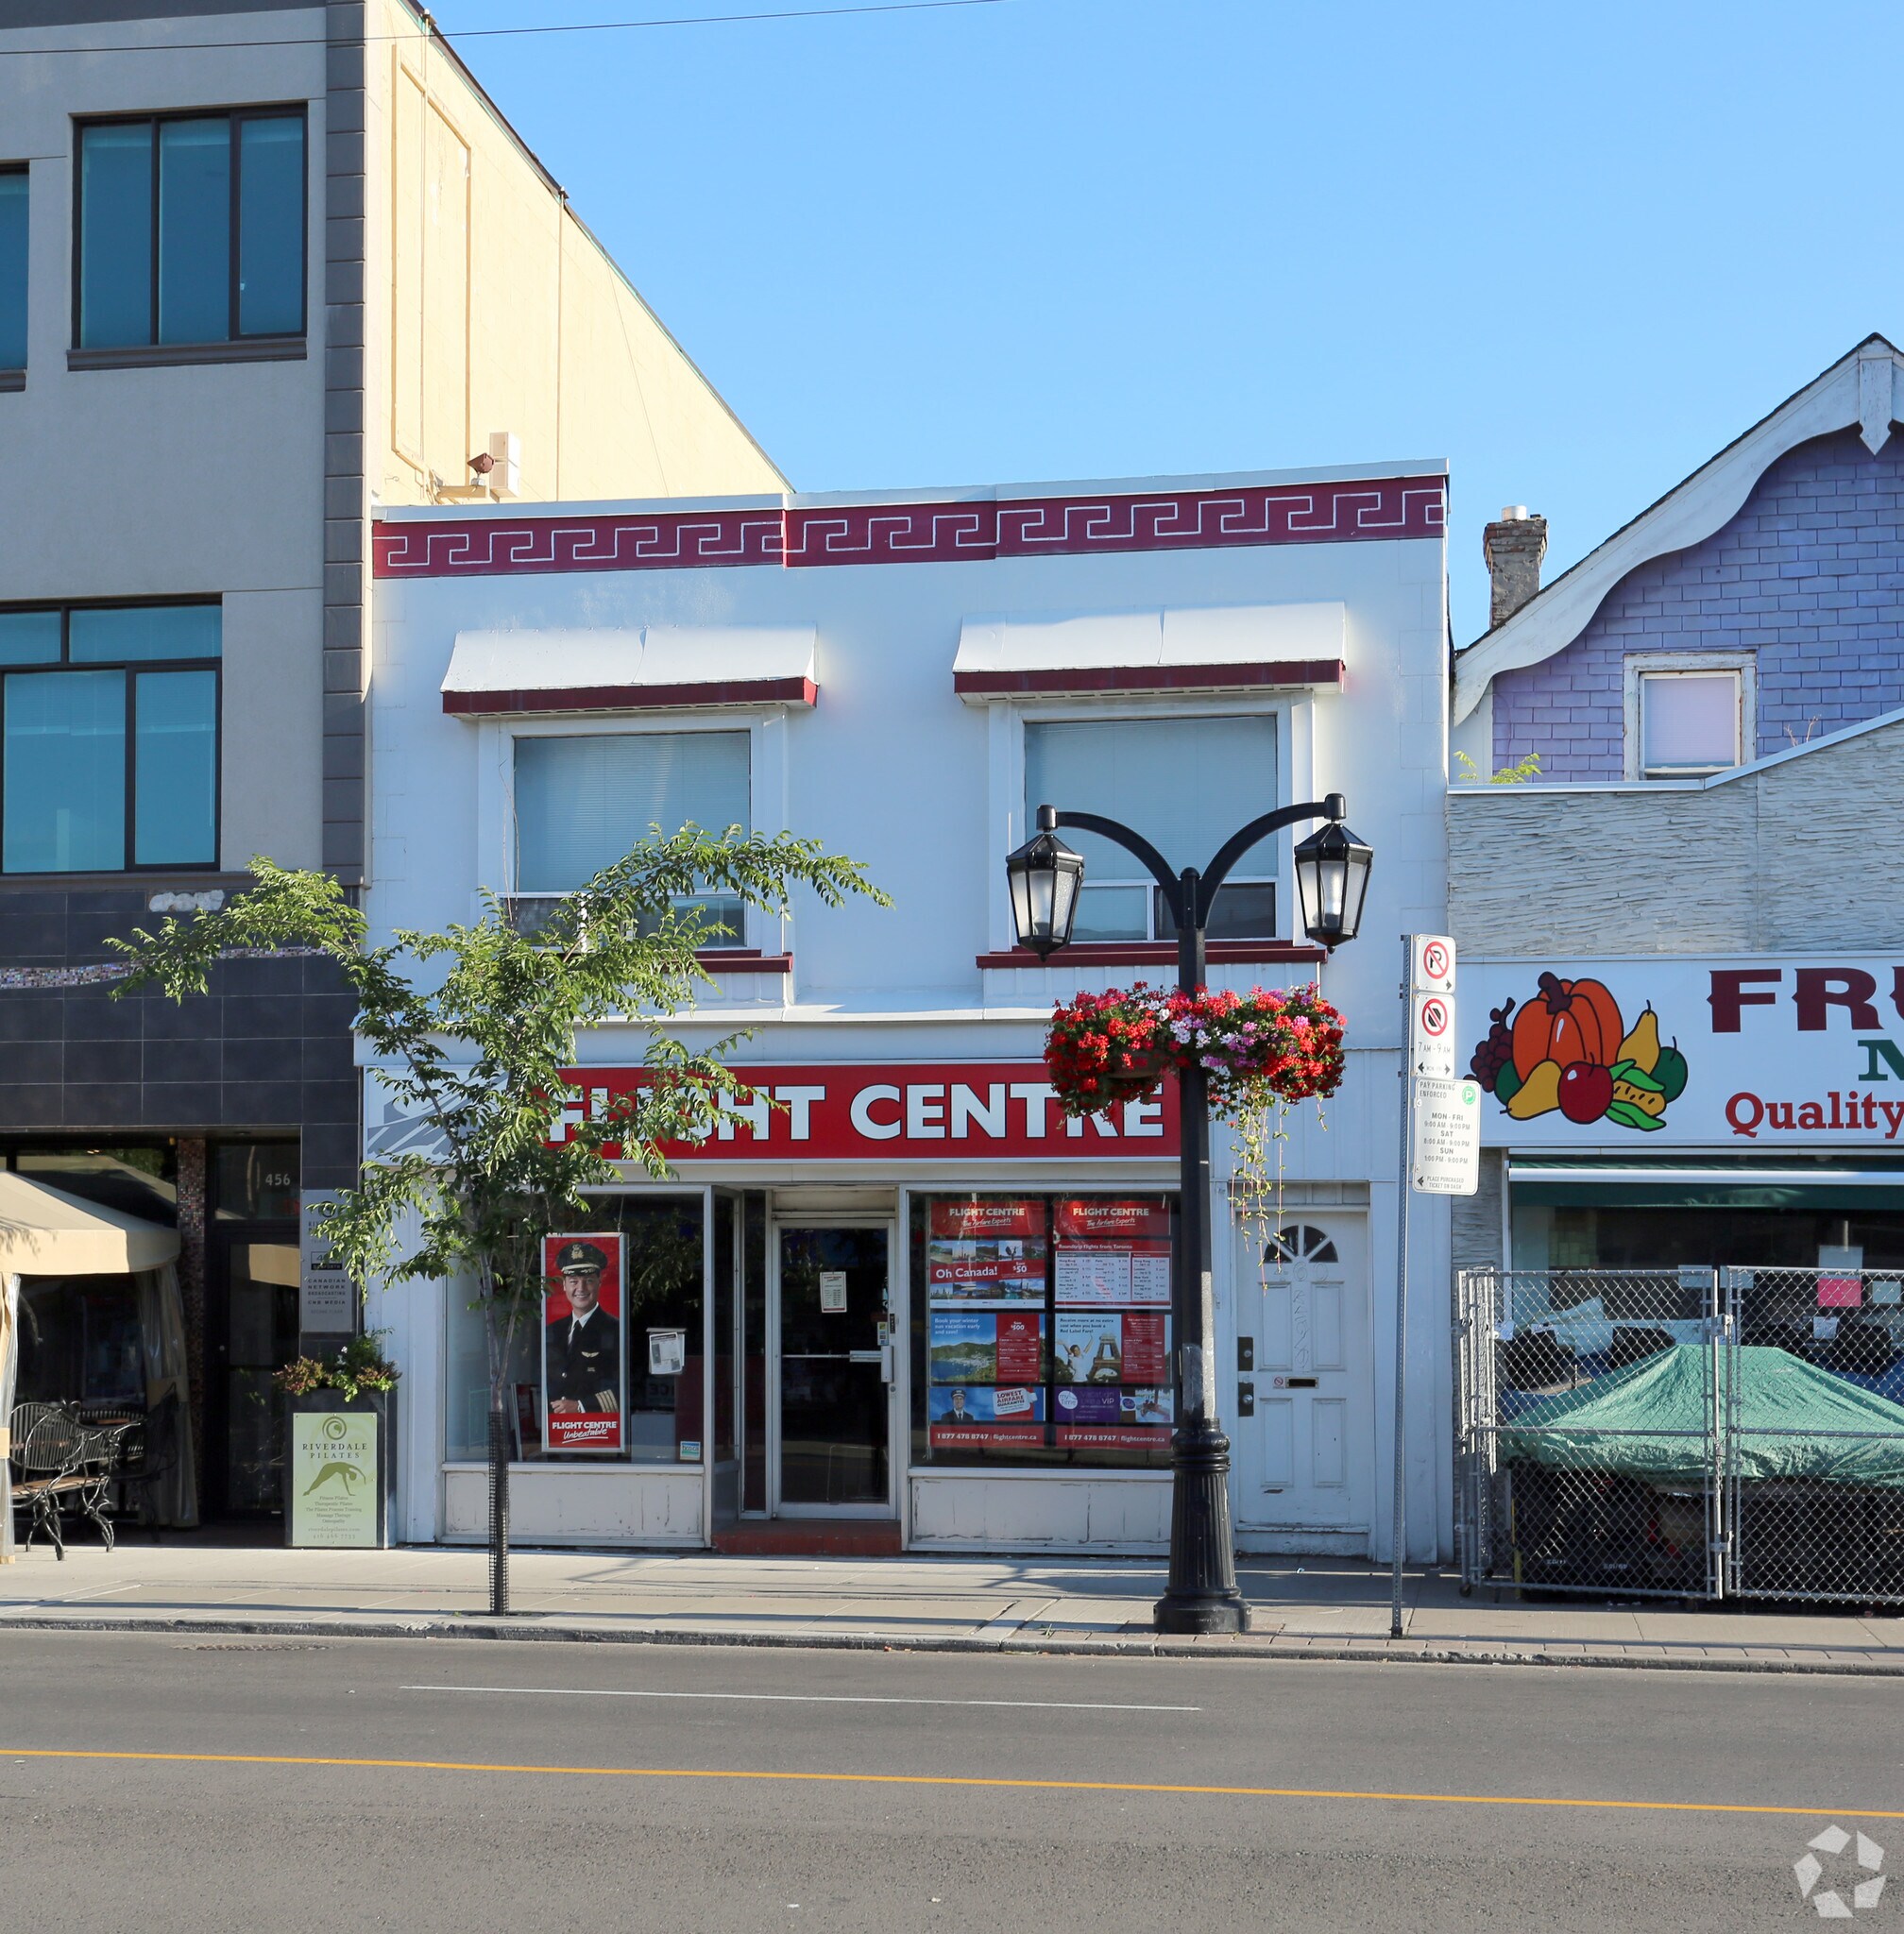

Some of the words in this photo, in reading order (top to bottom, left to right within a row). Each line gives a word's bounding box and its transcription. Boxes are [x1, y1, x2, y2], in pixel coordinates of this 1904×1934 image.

[1707, 966, 1904, 1032] FR
[1418, 1042, 1422, 1051] 7
[1437, 1043, 1441, 1053] 9
[1432, 1082, 1455, 1091] PARKING
[1726, 1091, 1904, 1139] Quality
[265, 1174, 290, 1186] 456
[949, 1208, 984, 1216] FLIGHT
[986, 1208, 1025, 1216] CENTRE
[1073, 1208, 1109, 1216] FLIGHT
[1110, 1208, 1149, 1216] CENTRE
[936, 1269, 952, 1279] Oh
[956, 1266, 997, 1278] Canada!
[996, 1390, 1022, 1399] LOWEST
[996, 1395, 1024, 1403] AIRFARE
[563, 1427, 607, 1439] Unbeatable
[302, 1442, 367, 1450] RIVERDALE
